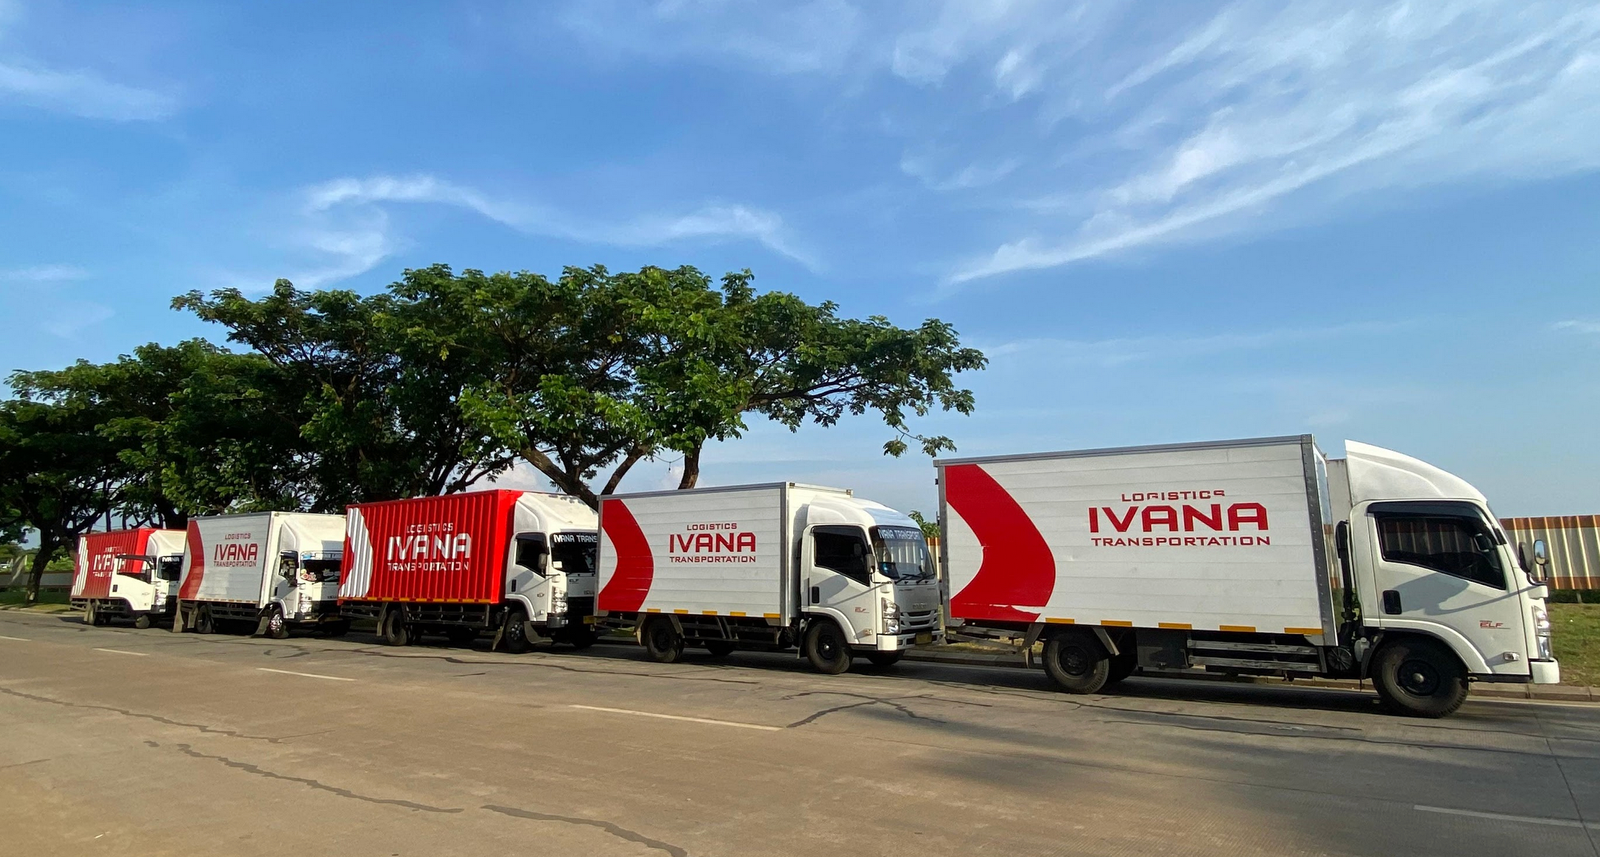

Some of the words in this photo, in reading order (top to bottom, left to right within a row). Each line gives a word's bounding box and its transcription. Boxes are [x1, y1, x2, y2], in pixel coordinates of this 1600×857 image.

[1088, 502, 1269, 533] IVANA
[406, 522, 454, 533] LOGISTICS
[686, 522, 738, 531] LOGISTICS
[224, 532, 252, 540] LOGISTICS
[553, 534, 575, 543] IVANA
[1091, 536, 1271, 547] TRANSPORTATION
[387, 532, 472, 561] IVANA
[670, 532, 756, 554] IVANA
[213, 543, 258, 561] IVANA
[213, 560, 257, 568] TRANSPORTATION
[669, 555, 757, 564] TRANSPORTATION
[387, 561, 470, 572] TRANSPORTATION
